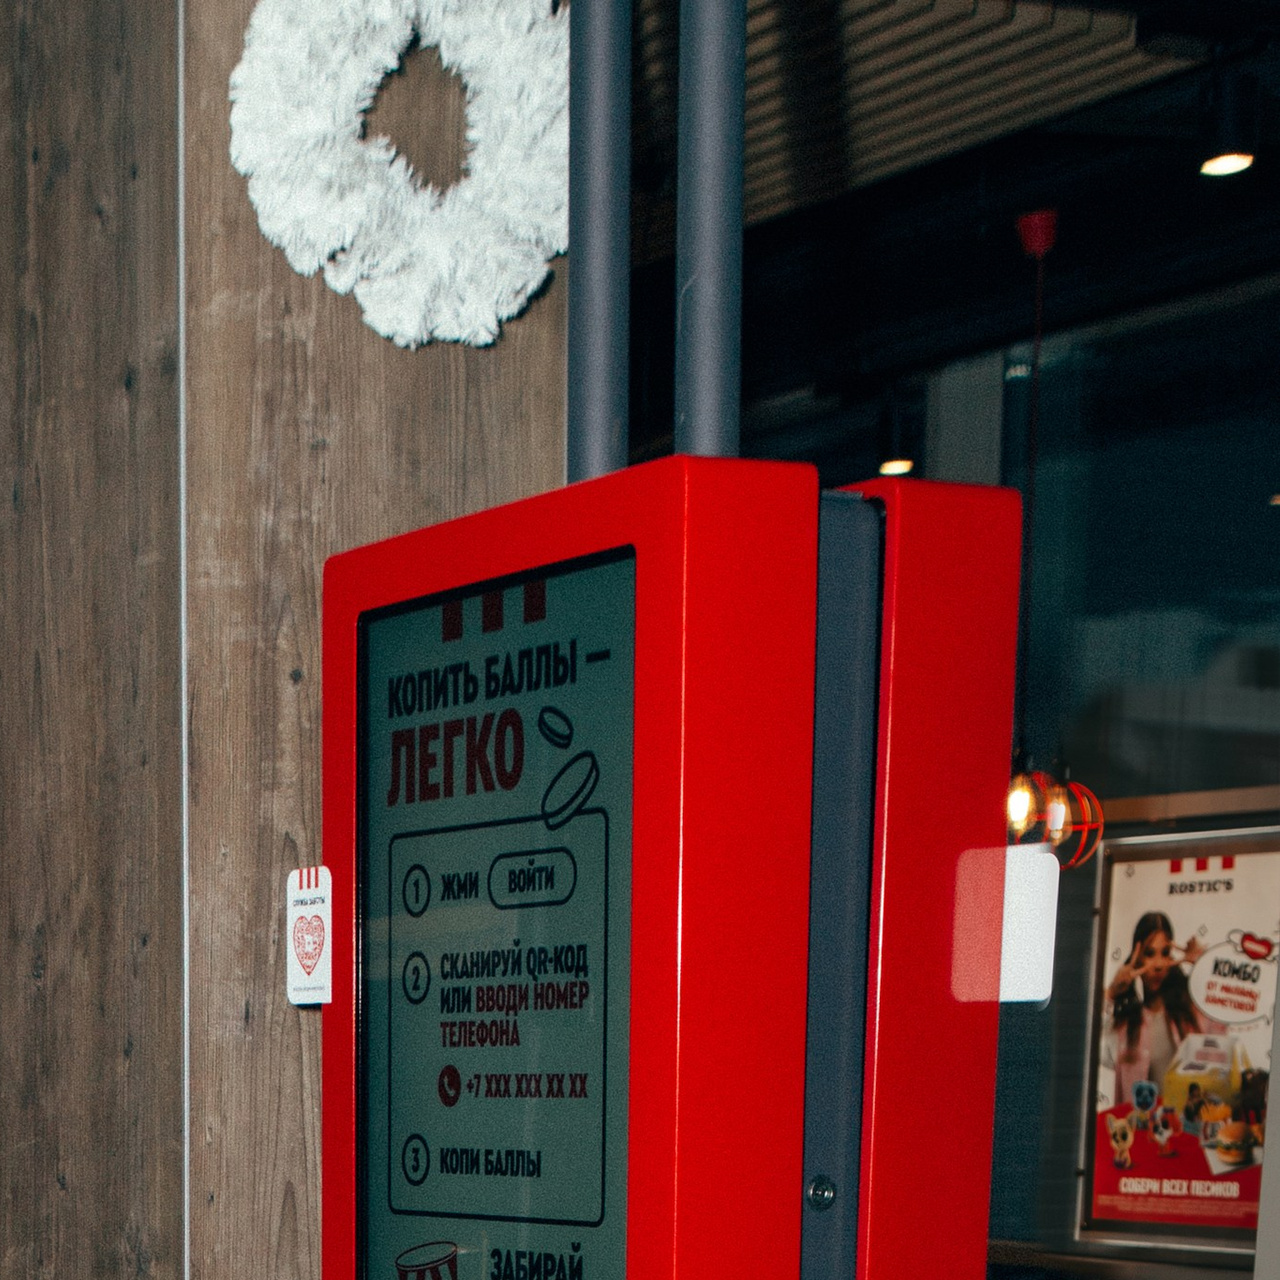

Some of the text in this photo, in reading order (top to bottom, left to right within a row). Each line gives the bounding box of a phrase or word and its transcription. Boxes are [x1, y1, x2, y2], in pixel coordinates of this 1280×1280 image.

[387, 660, 478, 718] КОПИТЬ
[484, 639, 577, 702] БАЛЛЫ
[387, 707, 524, 807] ЛЕГКО
[413, 858, 555, 904] 1 ЖМИ ВОЙТИ
[1168, 878, 1234, 895] ROSTIC'S
[412, 939, 589, 991] 2 СКАНИРУЙ QR-КОД
[1212, 957, 1261, 983] КОМБО
[440, 981, 589, 1016] ИЛИ ВВОДИ НОМЕР
[440, 1019, 520, 1048] ТЕЛЕФОНА
[467, 1074, 481, 1098] +7
[411, 1147, 541, 1177] 3 КОПИ БАЛЛЫ
